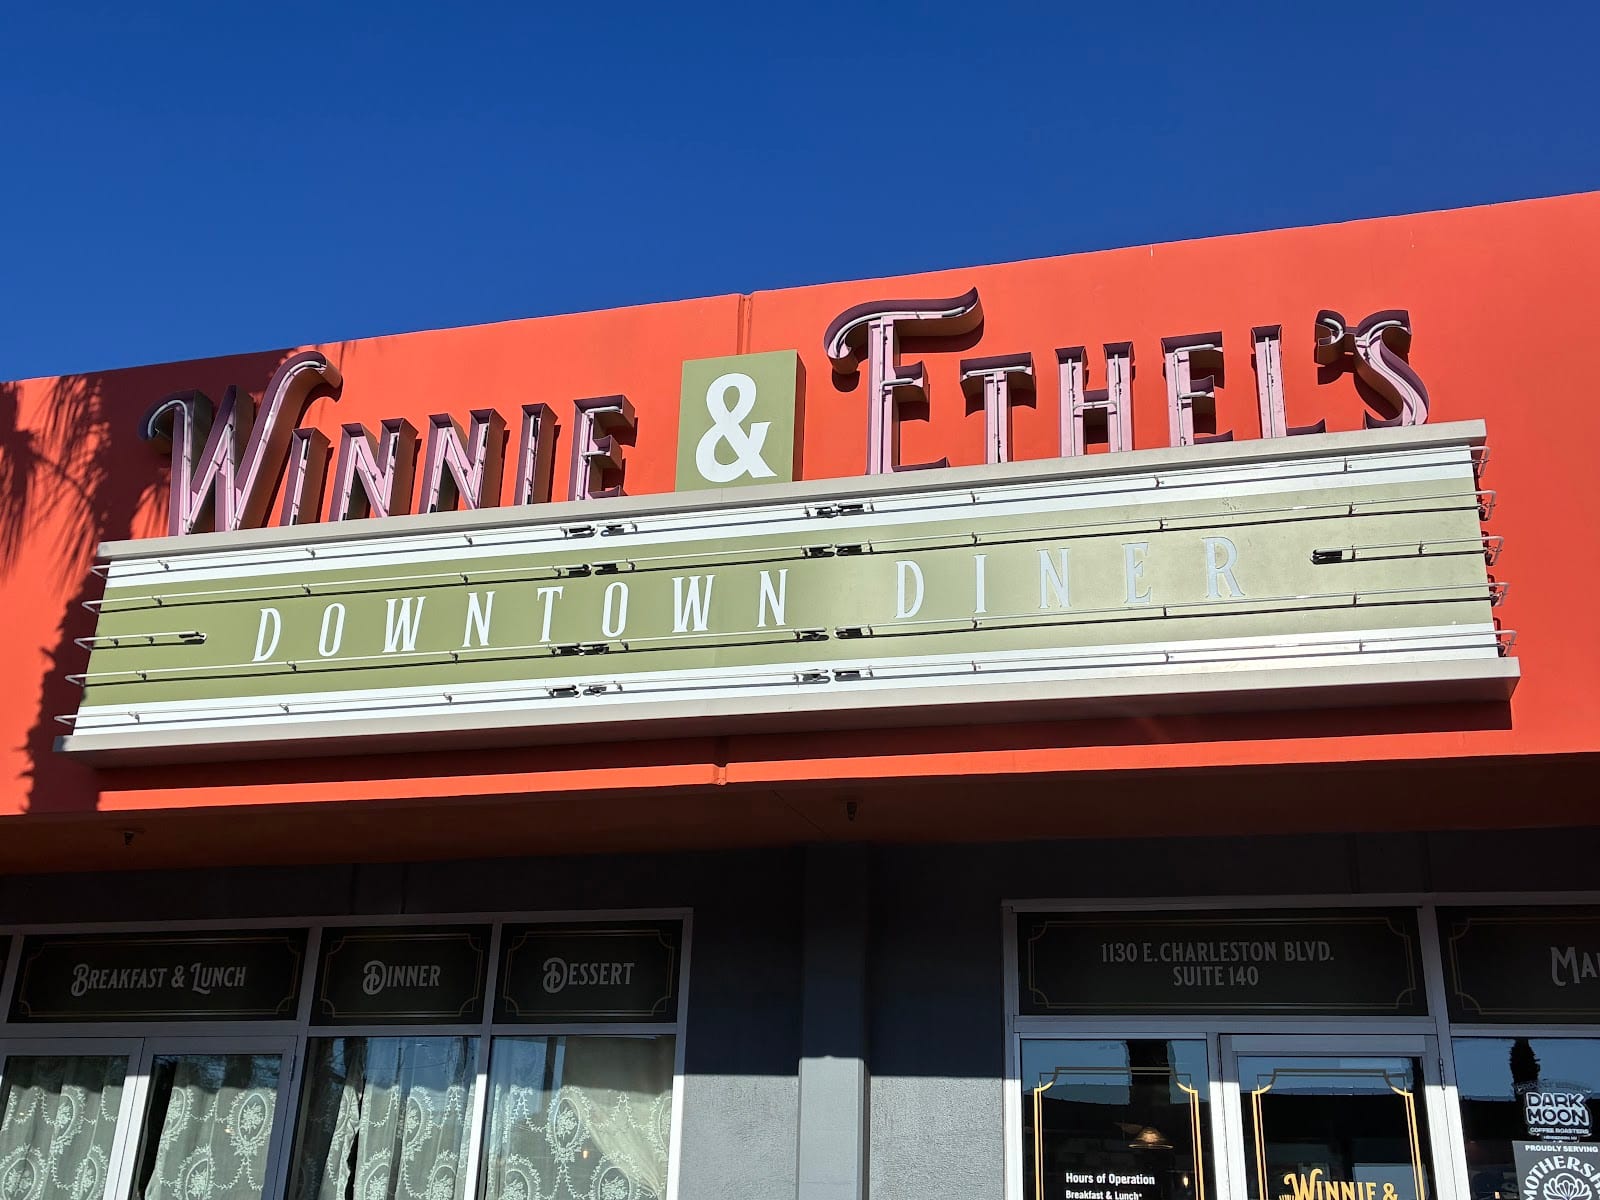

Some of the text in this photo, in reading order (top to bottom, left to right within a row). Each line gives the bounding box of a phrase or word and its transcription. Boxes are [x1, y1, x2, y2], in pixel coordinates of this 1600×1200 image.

[138, 350, 638, 536] WINNIE
[694, 372, 778, 484] &
[252, 536, 1248, 664] DOWNTOWN DINER
[1101, 941, 1335, 963] 1130 E. CHARLESTON BLVD.
[542, 957, 635, 994] DESSERT
[1173, 965, 1259, 986] SUITE 140
[1550, 946, 1600, 987] MA
[71, 962, 247, 997] BREAKFAST & LUNCH
[362, 959, 441, 996] DINNER
[1526, 1092, 1585, 1108] DARK
[1526, 1106, 1590, 1126] MOON
[1555, 1127, 1590, 1135] ROASTERS
[1524, 1144, 1599, 1153] PROUDLY SERVING
[1065, 1172, 1156, 1187] Hours of Operation
[1065, 1190, 1104, 1200] Breakfast
[1105, 1190, 1113, 1200] &
[1382, 1182, 1398, 1200] &
